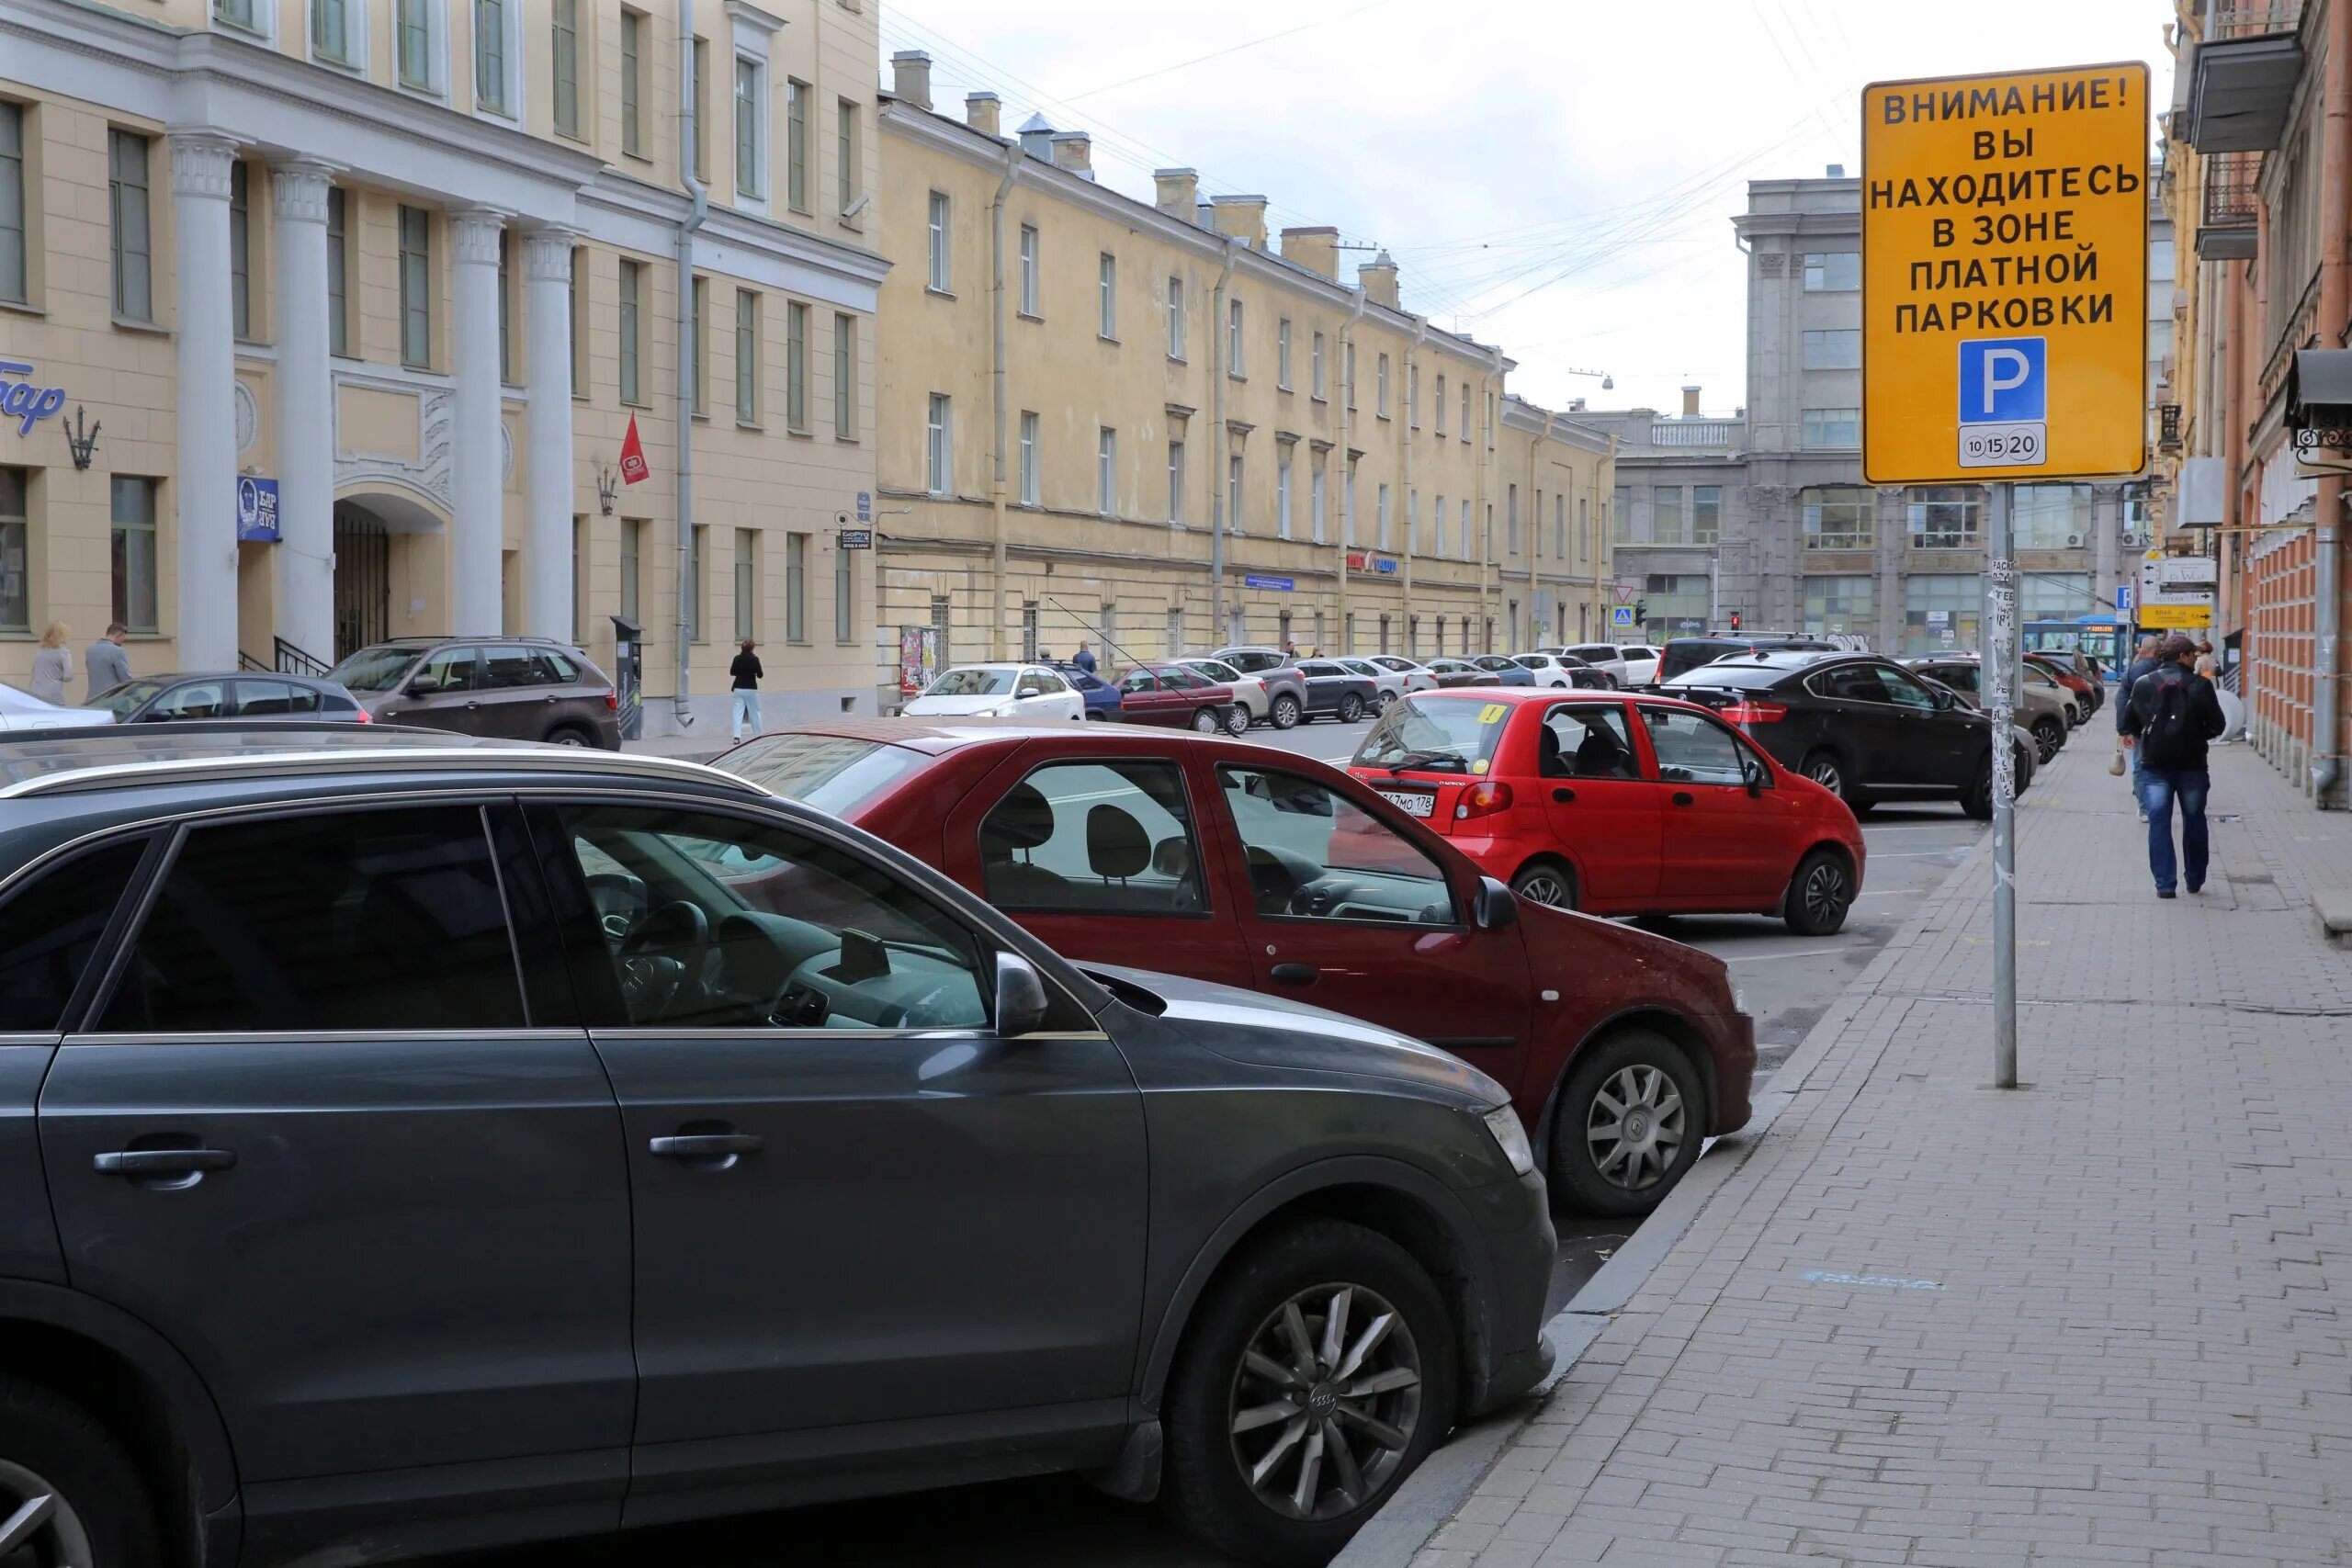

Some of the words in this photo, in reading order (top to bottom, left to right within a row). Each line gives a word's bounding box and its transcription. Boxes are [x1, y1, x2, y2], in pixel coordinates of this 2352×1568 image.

[1883, 77, 2128, 125] ВНИМАНИЕ!
[1973, 128, 2034, 161] ВЫ
[1870, 164, 2140, 209] НАХОДИТЕСЬ
[1932, 218, 1955, 248] В
[1972, 209, 2075, 245] ЗОНЕ
[1910, 242, 2098, 291] ПЛАТНОЙ
[1894, 293, 2113, 333] ПАРКОВКИ
[1982, 348, 2030, 414] P
[1968, 441, 1983, 453] 10
[1986, 437, 2004, 454] 15
[2009, 434, 2036, 455] 20
[258, 490, 277, 509] БАР
